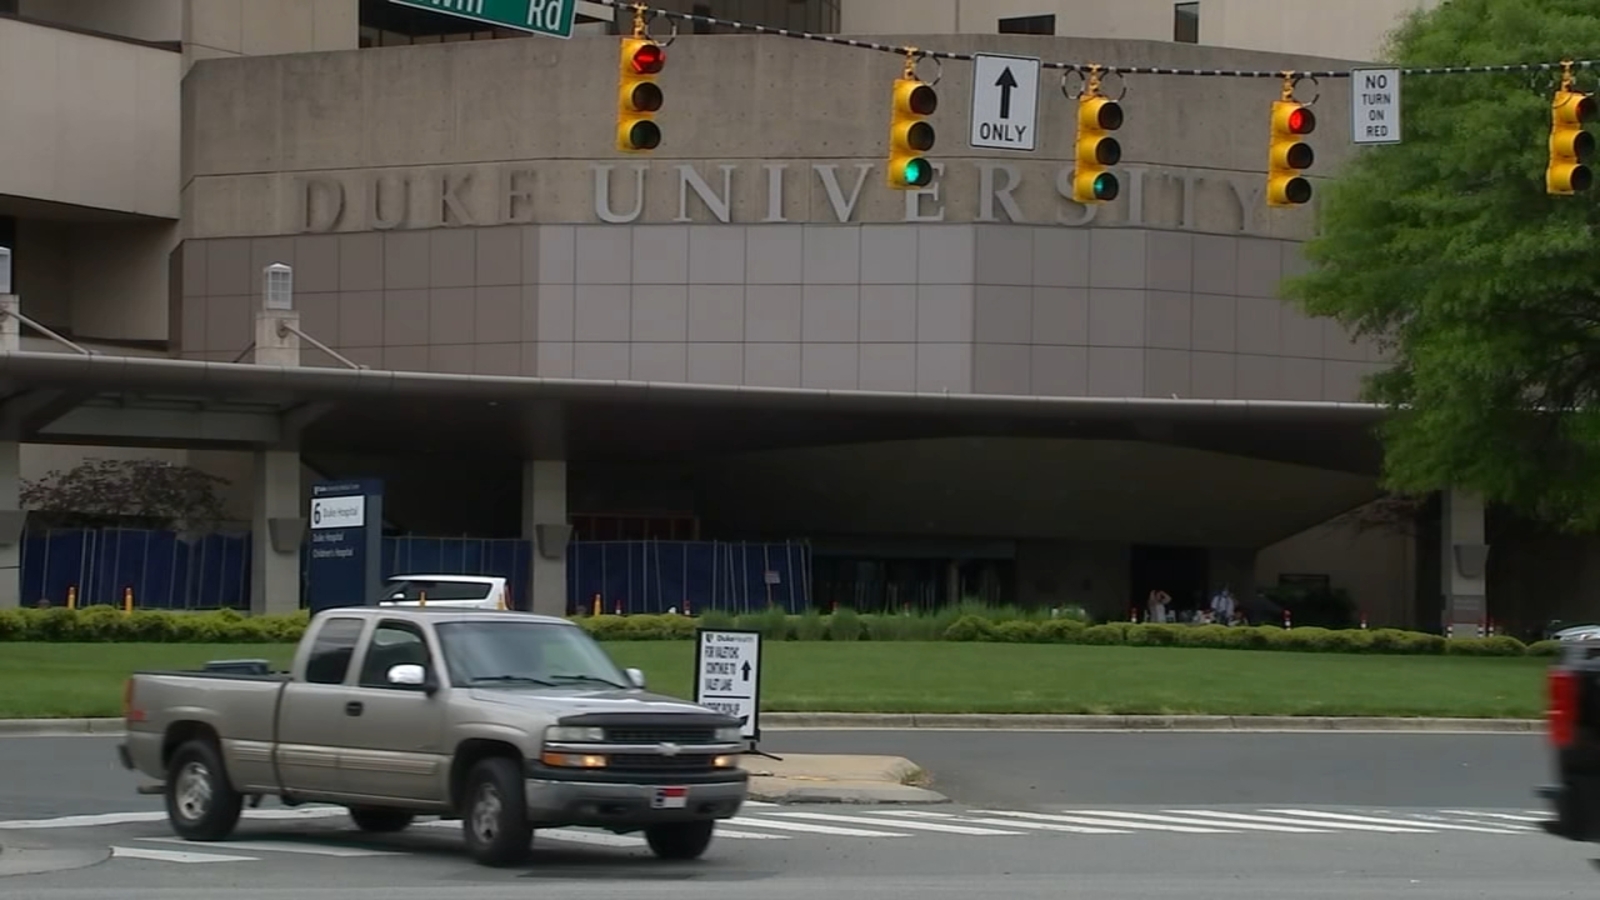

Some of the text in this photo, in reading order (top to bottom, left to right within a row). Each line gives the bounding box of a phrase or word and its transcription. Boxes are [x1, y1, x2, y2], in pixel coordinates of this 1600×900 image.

[527, 0, 564, 30] Rd
[1365, 74, 1387, 89] NO
[1362, 93, 1391, 105] TURN
[1369, 109, 1384, 121] ON
[980, 122, 1027, 142] ONLY
[1366, 125, 1388, 137] RED
[300, 166, 537, 234] DUKE
[591, 161, 1263, 232] UNIVERSITY
[313, 502, 321, 525] 6
